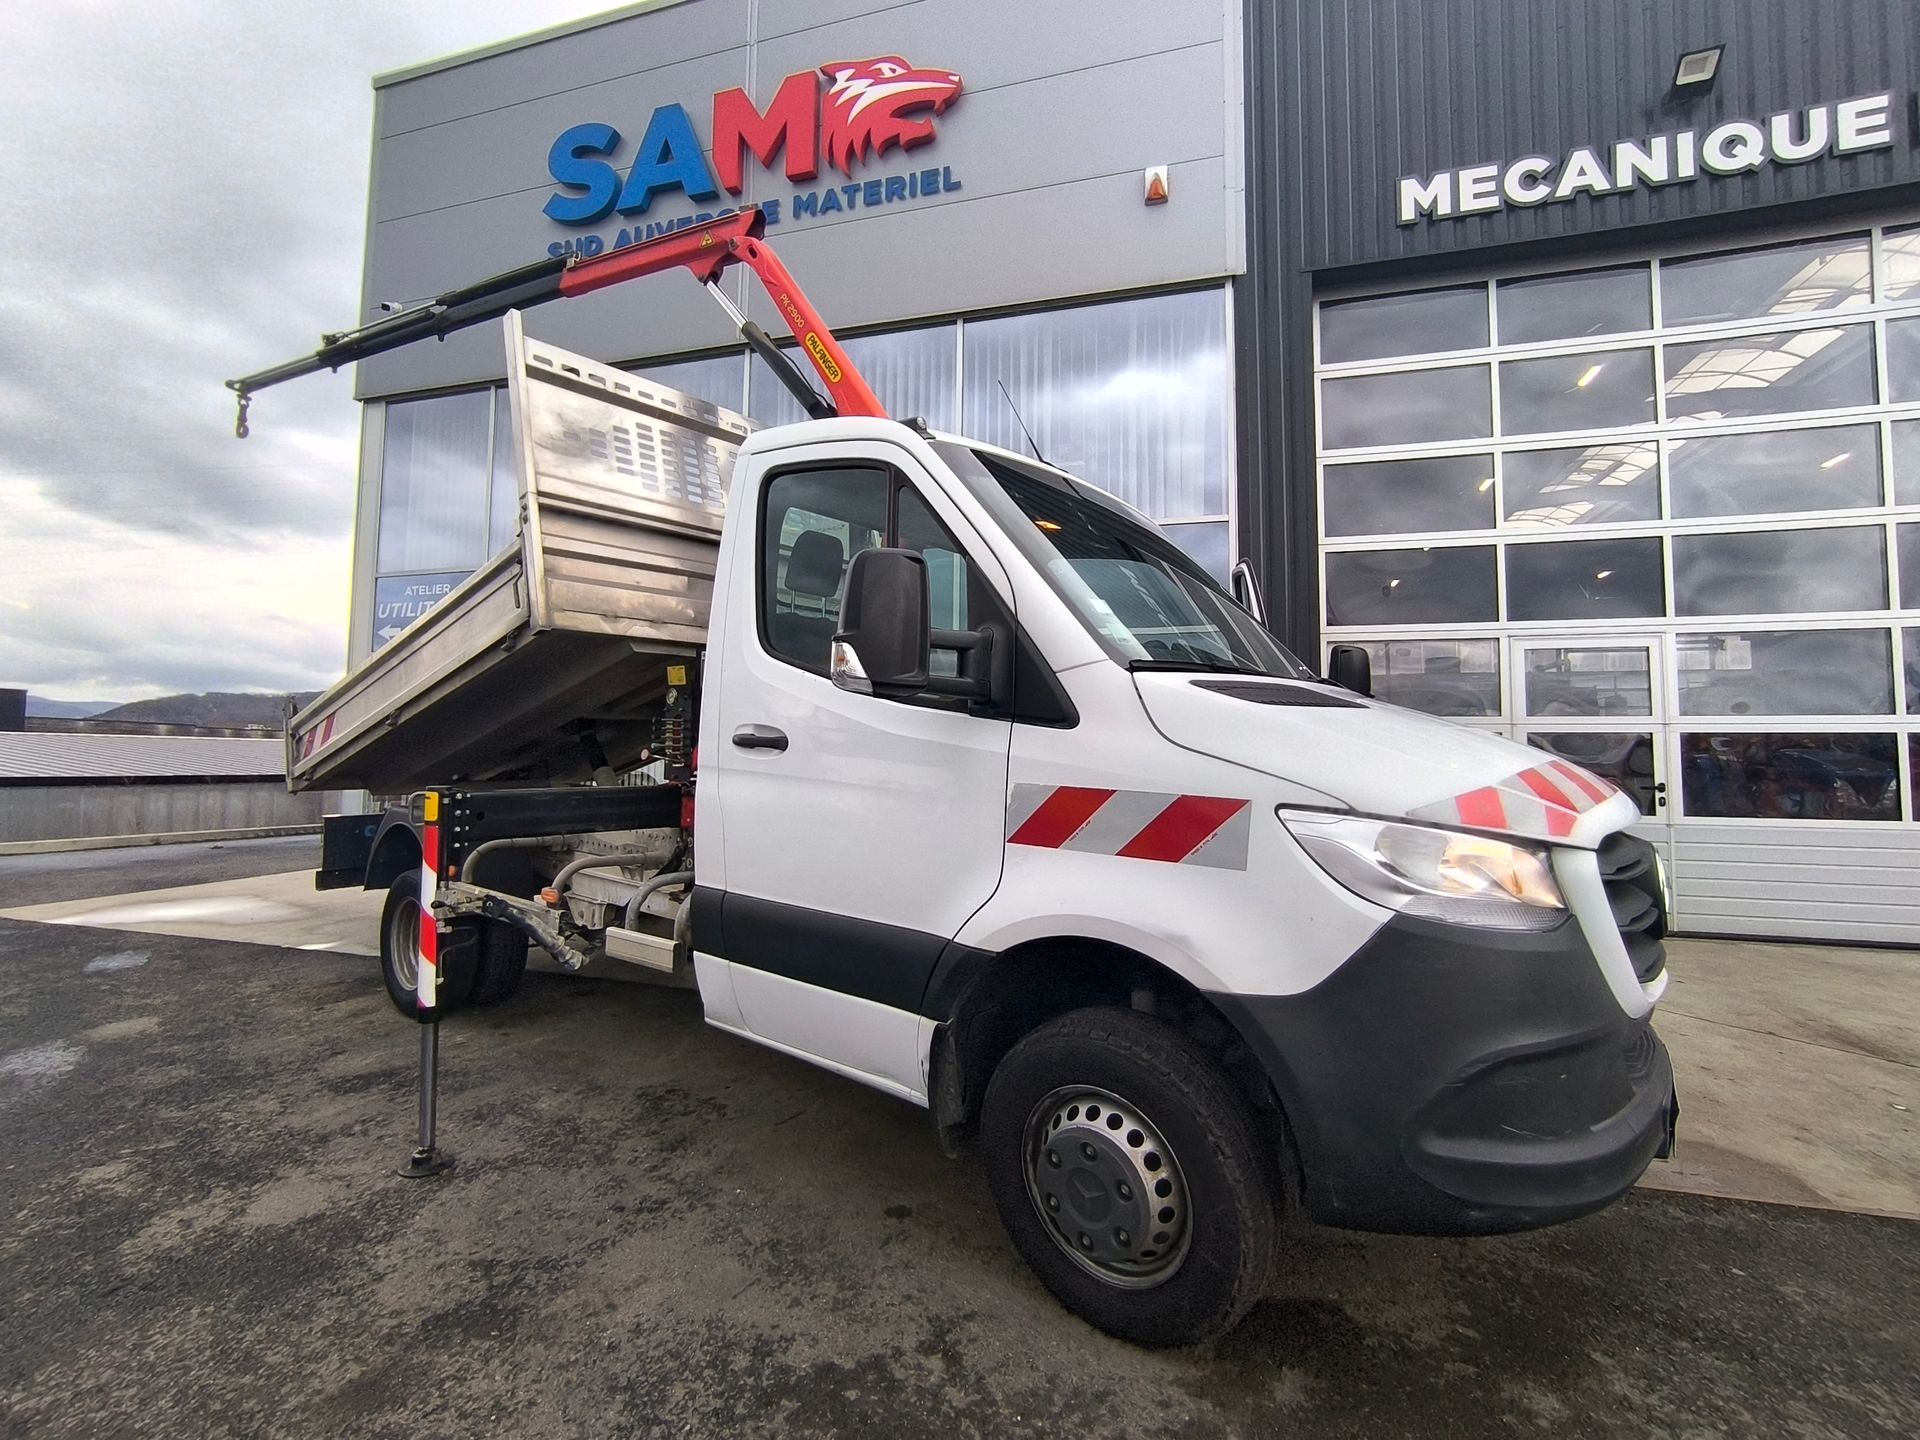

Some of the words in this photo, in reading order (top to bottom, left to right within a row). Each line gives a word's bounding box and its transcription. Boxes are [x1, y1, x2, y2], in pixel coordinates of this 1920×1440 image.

[543, 69, 820, 226] SAM
[1399, 95, 1891, 222] MECANIQUE
[793, 166, 962, 219] MATERIEL
[780, 293, 790, 307] PK
[787, 305, 805, 328] 2900
[807, 335, 839, 380] PALFINGER
[404, 584, 451, 596] ATELIER
